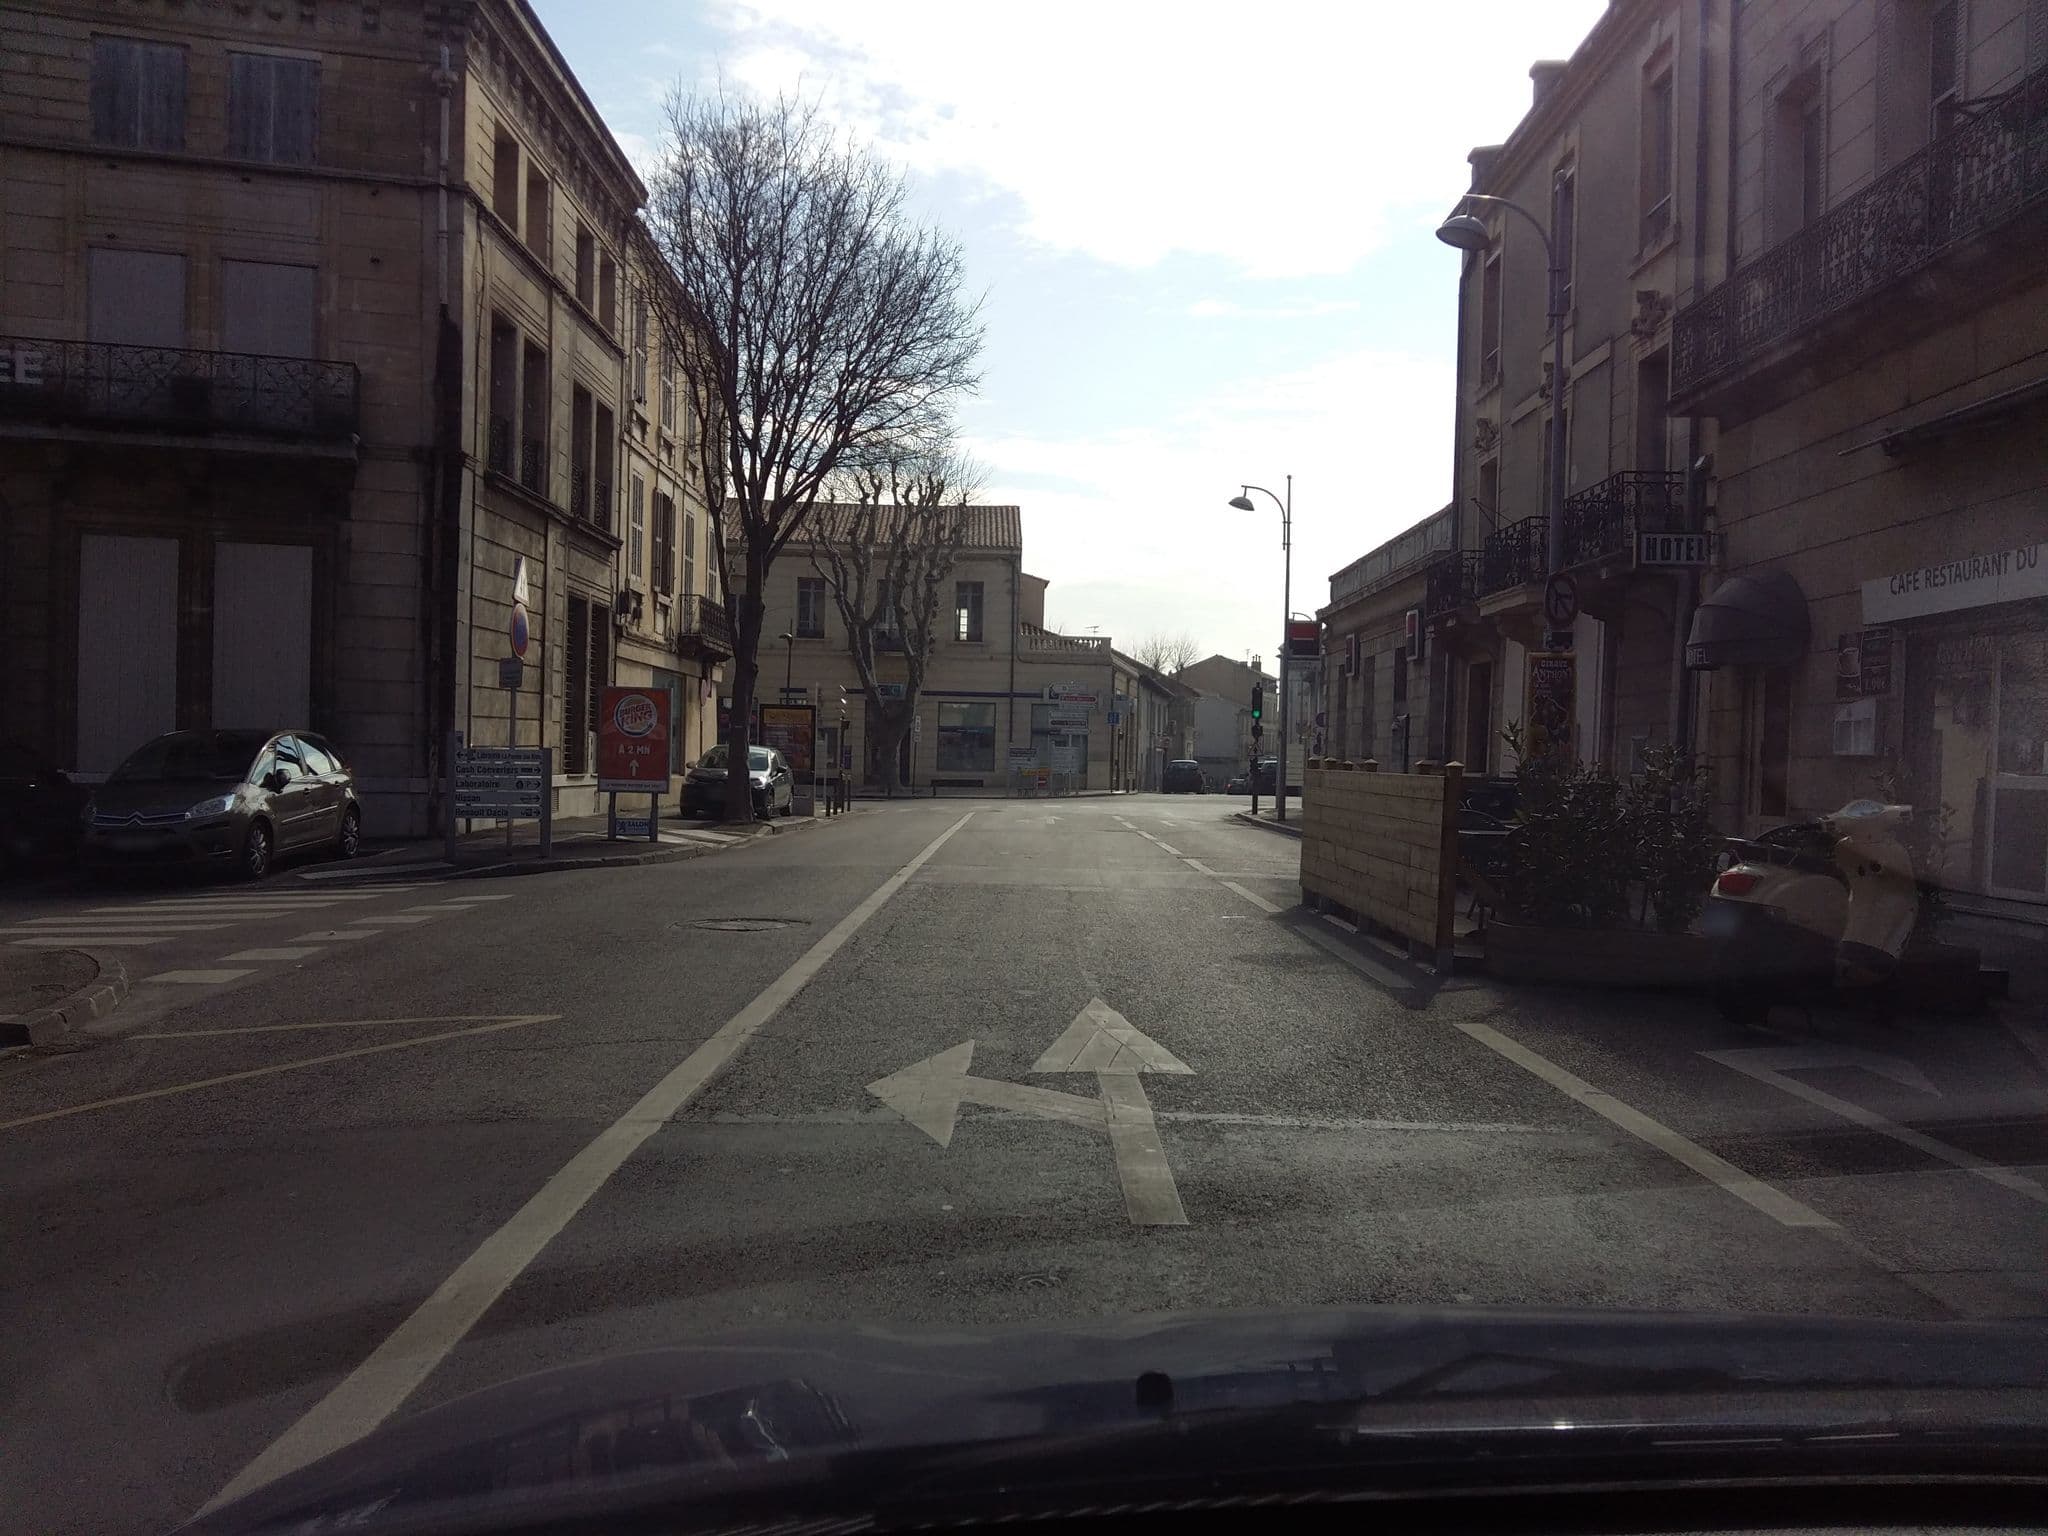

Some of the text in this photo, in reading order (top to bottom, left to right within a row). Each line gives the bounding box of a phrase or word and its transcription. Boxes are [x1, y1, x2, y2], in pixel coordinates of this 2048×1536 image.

[1645, 537, 1704, 561] HOTEL
[1924, 552, 2010, 588] RESTAURANT
[2015, 545, 2038, 571] DU
[1686, 648, 1711, 666] OTEL
[619, 703, 651, 718] BURGER
[622, 711, 652, 727] KING
